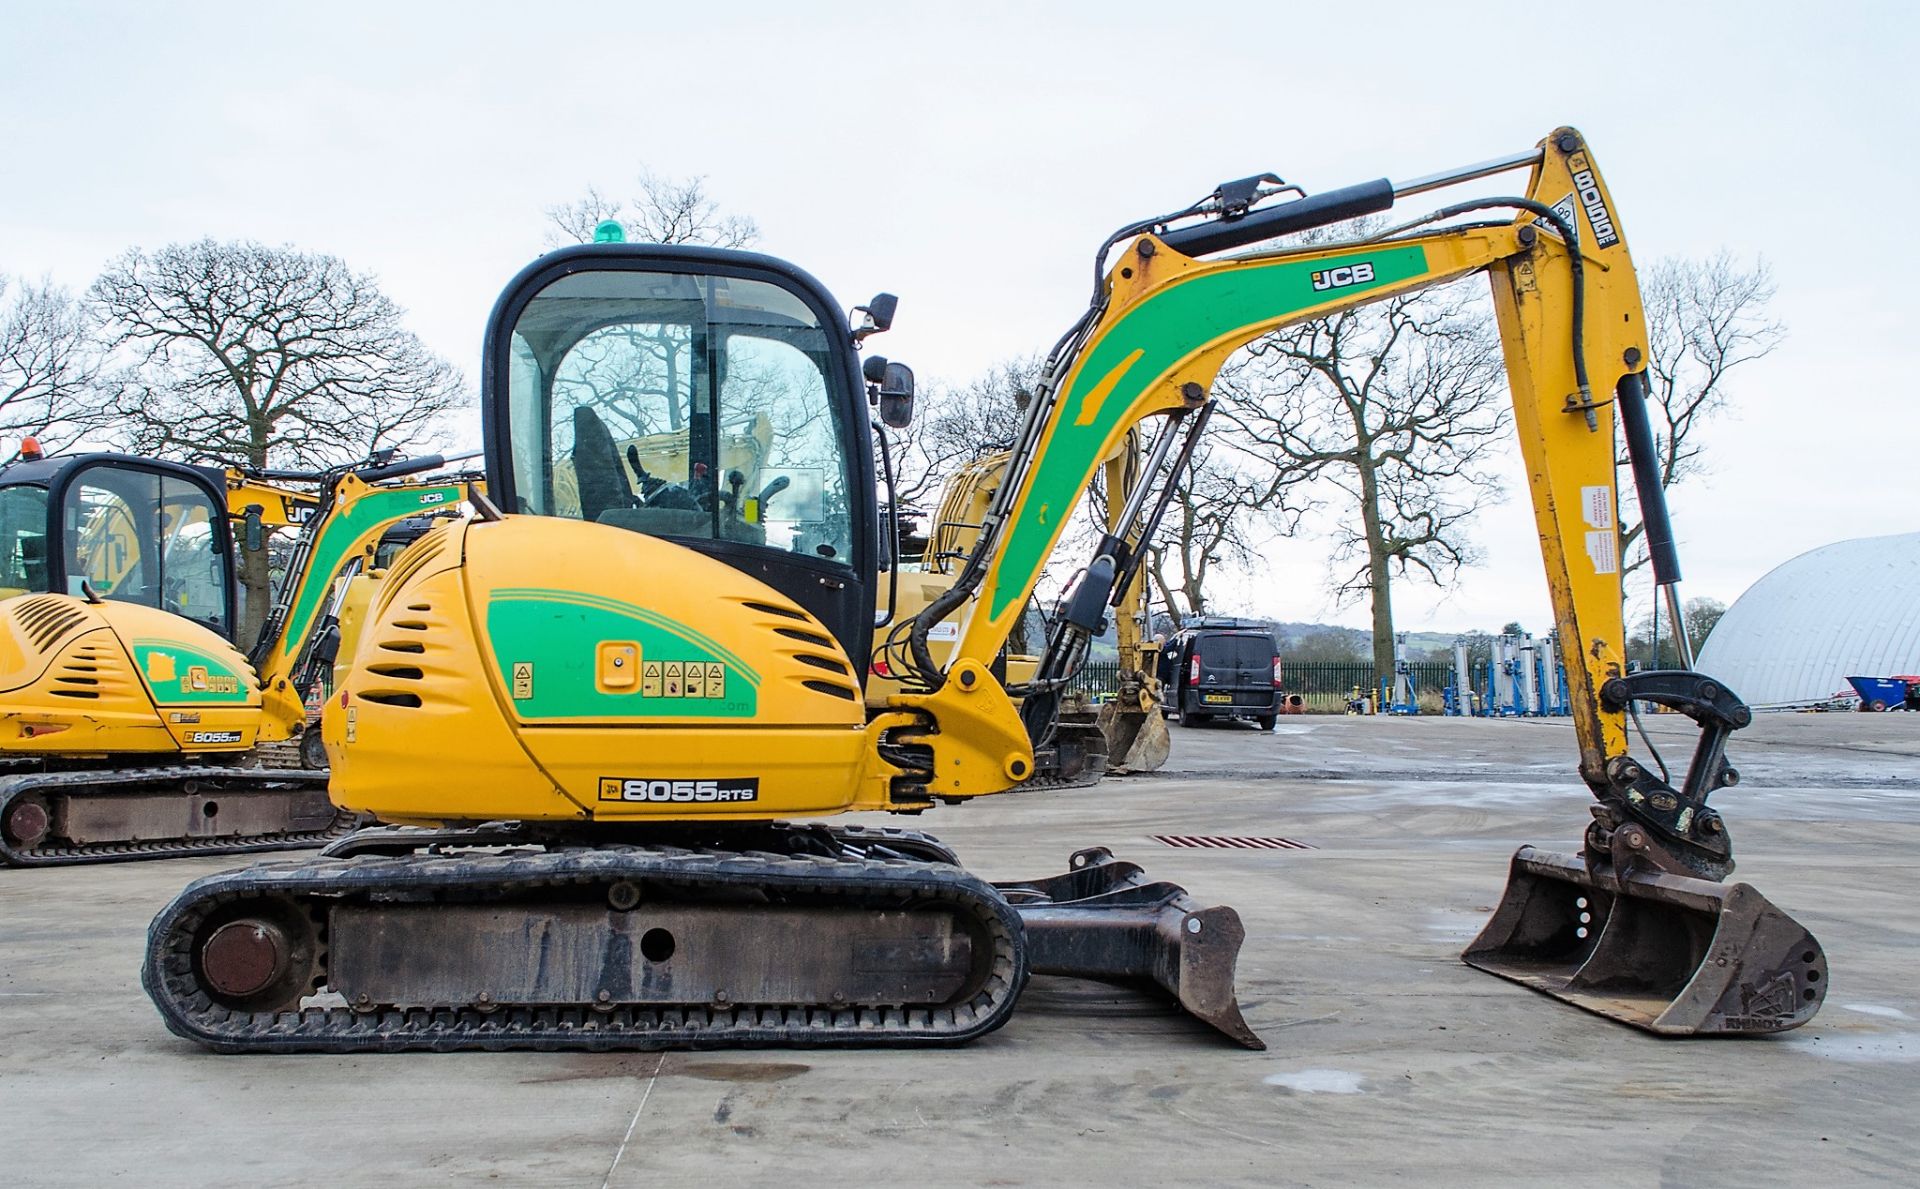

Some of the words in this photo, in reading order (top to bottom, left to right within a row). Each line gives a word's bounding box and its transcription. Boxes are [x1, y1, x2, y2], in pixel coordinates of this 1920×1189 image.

[1312, 263, 1375, 290] JCB
[419, 493, 443, 504] JCB
[287, 506, 316, 523] JC
